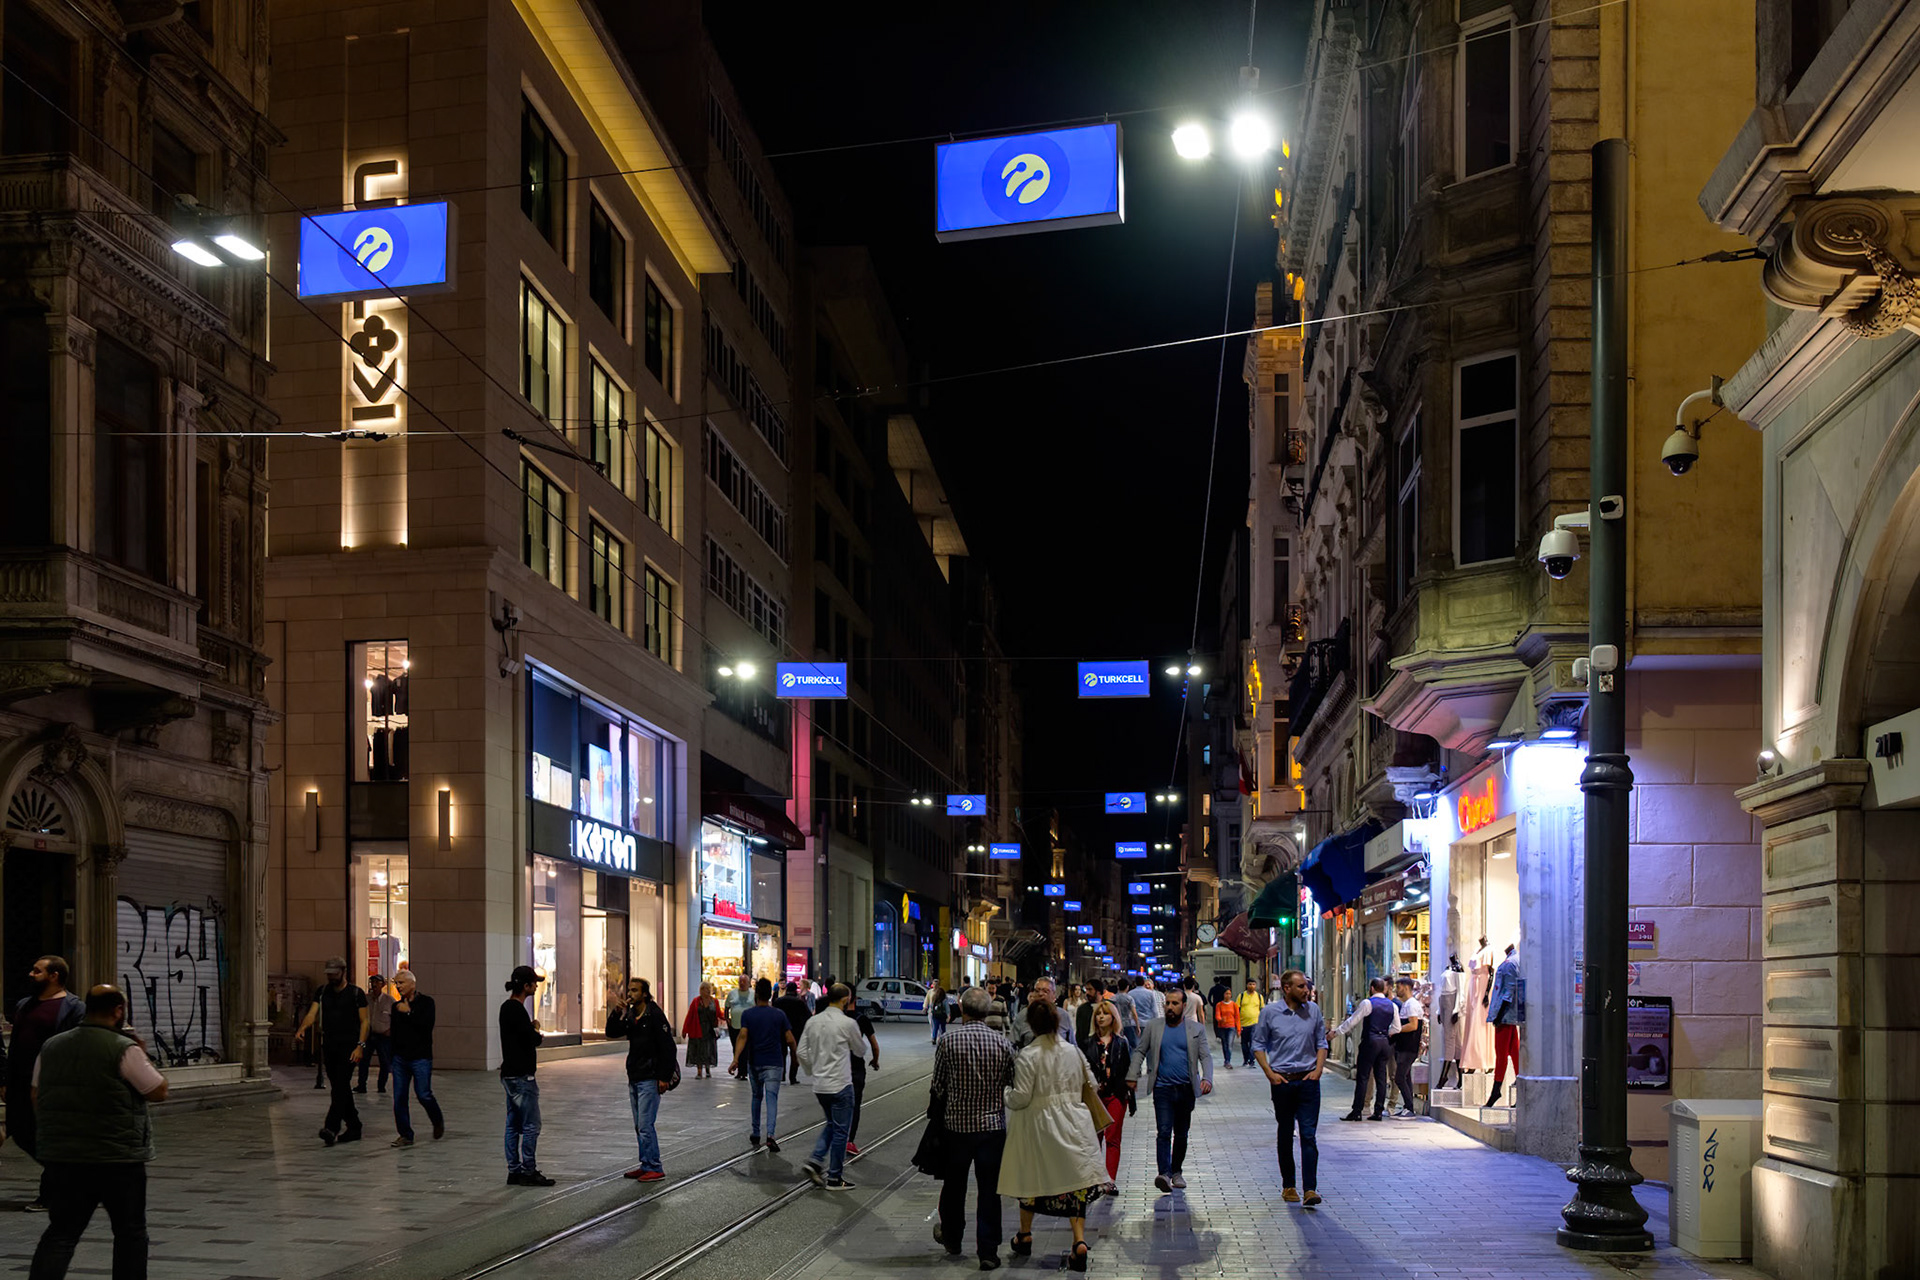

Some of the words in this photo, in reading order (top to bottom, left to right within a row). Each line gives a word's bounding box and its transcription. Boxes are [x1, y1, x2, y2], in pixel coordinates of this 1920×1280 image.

[796, 676, 842, 684] TURKCELL
[1098, 675, 1144, 683] TURKCELL
[1628, 924, 1646, 932] LAR
